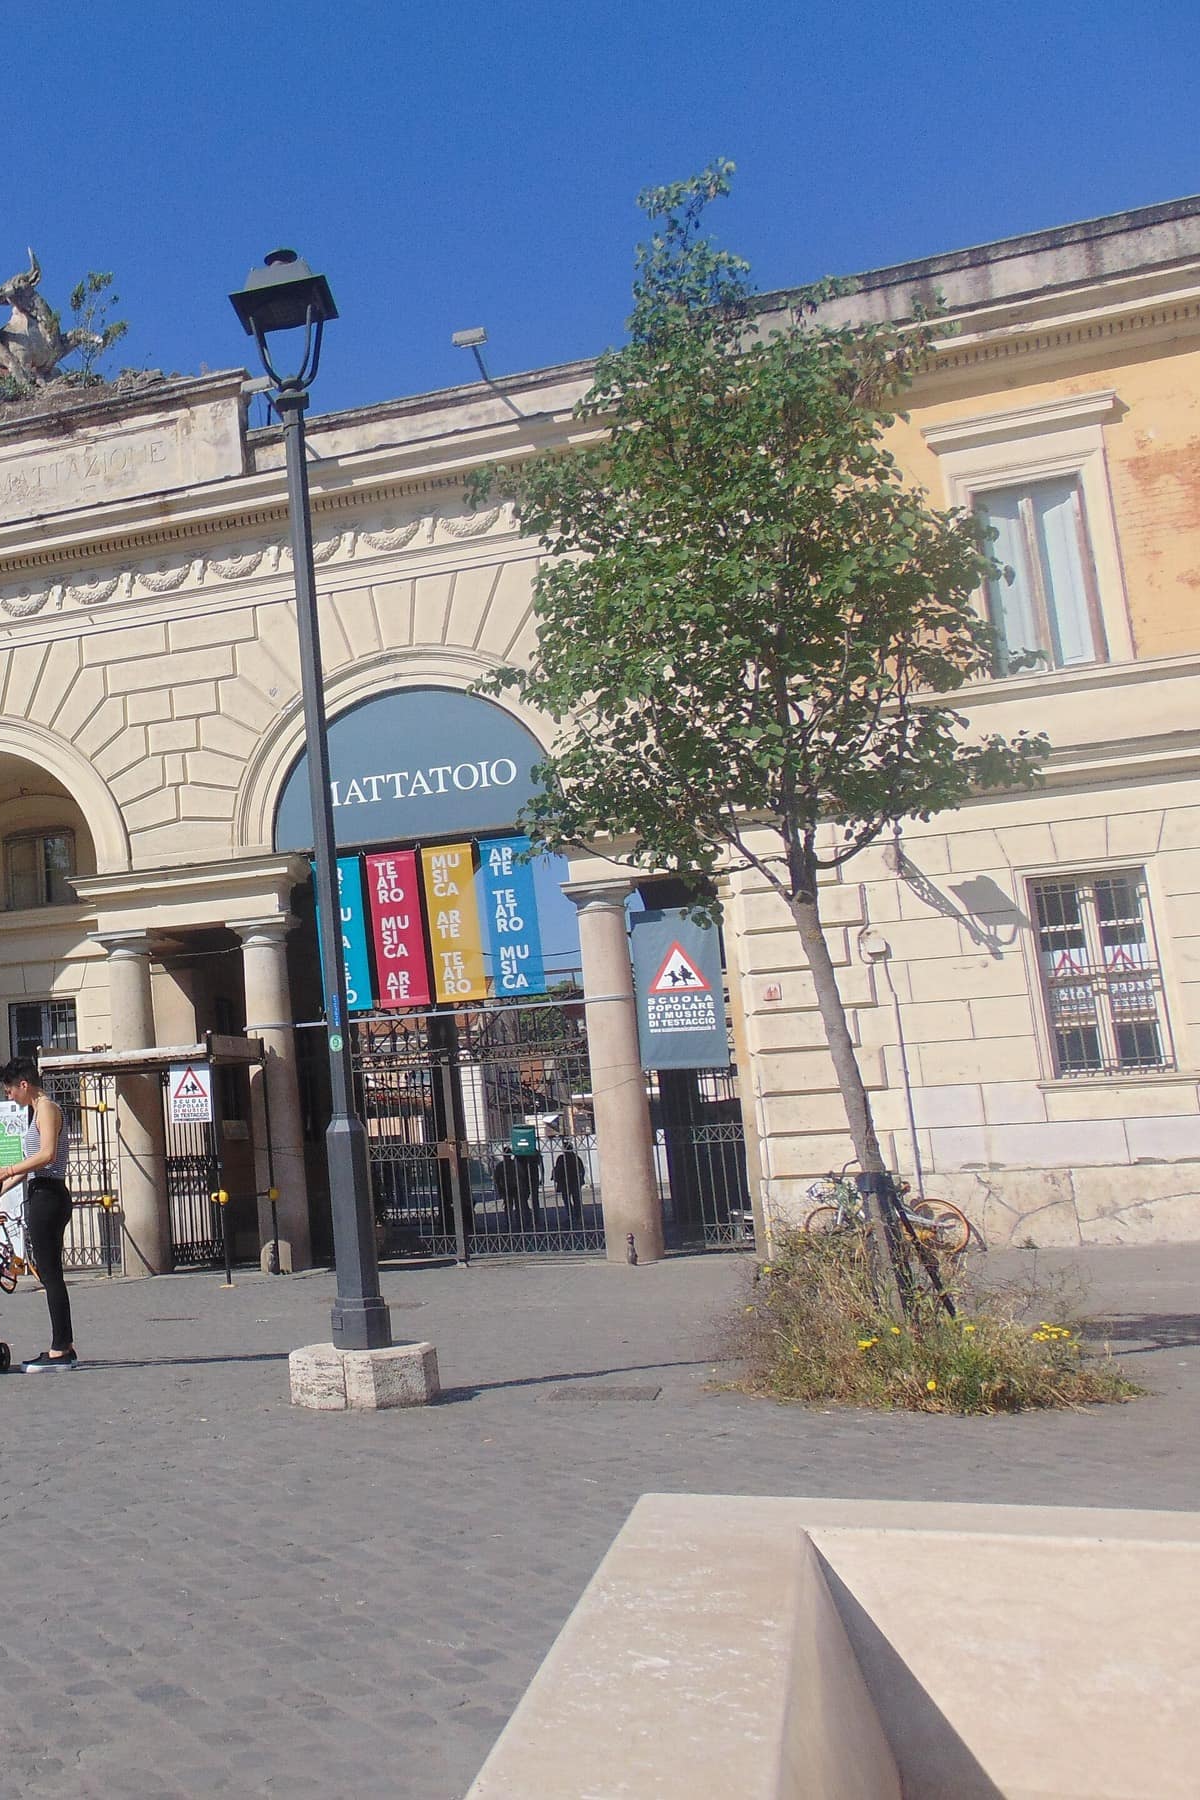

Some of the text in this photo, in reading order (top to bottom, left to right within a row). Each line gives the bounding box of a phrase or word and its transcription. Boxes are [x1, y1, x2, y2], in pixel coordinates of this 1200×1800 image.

[431, 853, 460, 870] MU
[488, 847, 513, 862] AR
[374, 861, 396, 876] TE
[432, 868, 448, 883] SI
[489, 860, 512, 876] TE
[376, 874, 398, 890] AT
[433, 881, 459, 897] CA
[378, 888, 404, 904] RO
[492, 889, 516, 904] TE
[436, 910, 462, 924] AR
[494, 903, 517, 918] AT
[380, 915, 409, 931] MU
[437, 923, 460, 938] TE
[497, 917, 524, 933] RO
[382, 929, 398, 944] SI
[383, 942, 408, 958] CA
[500, 944, 530, 960] MU
[440, 952, 462, 966] TE
[442, 964, 464, 980] AT
[501, 959, 517, 975] SI
[386, 971, 410, 986] AR
[502, 972, 529, 989] CA
[387, 985, 409, 1000] TE
[444, 978, 472, 995] RO
[647, 994, 713, 1005] SCUOLA
[647, 1002, 715, 1012] POPOLARE
[648, 1010, 715, 1020] DI MUSICA
[660, 1017, 716, 1027] TESTACCIO
